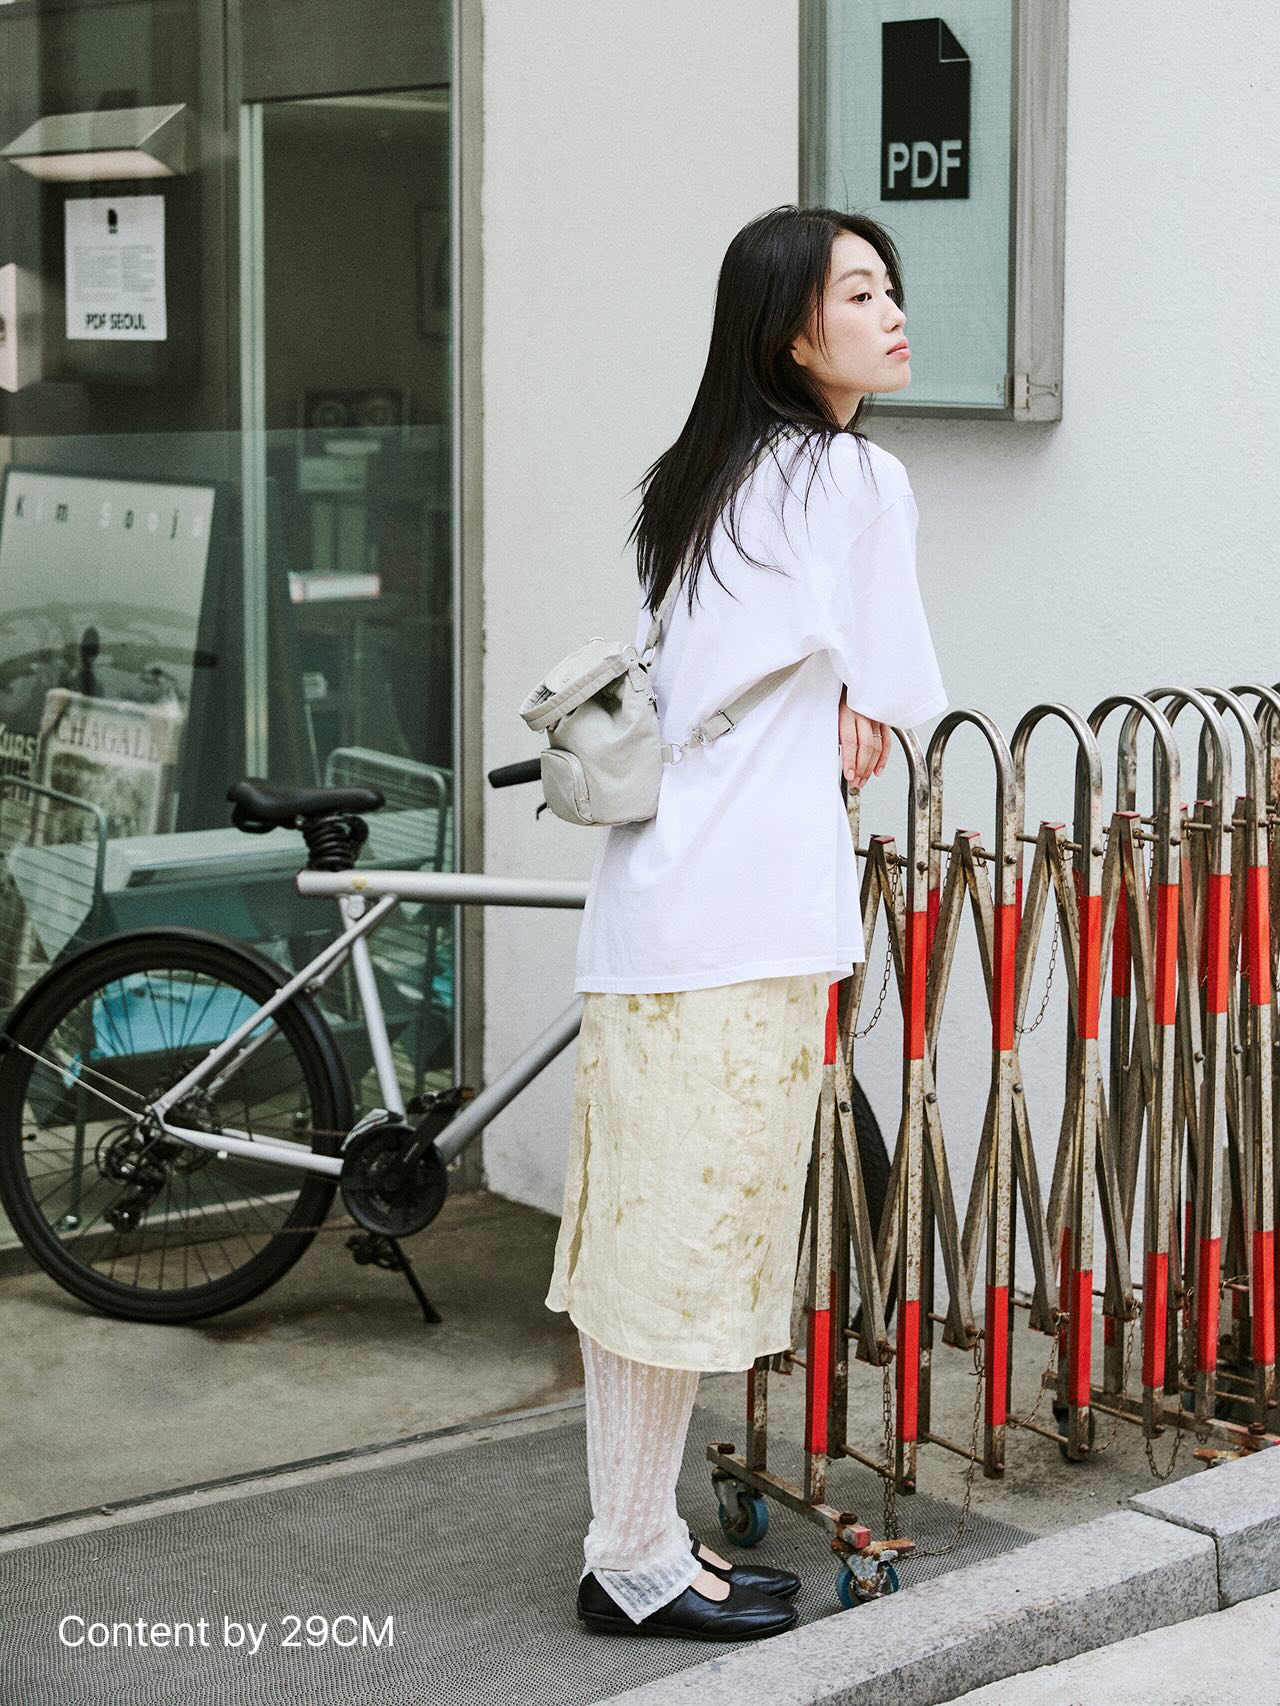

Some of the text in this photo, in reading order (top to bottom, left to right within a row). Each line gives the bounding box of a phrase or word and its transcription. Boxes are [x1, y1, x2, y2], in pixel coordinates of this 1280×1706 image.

[887, 139, 962, 189] PDF
[86, 312, 146, 331] PDF SEOUL
